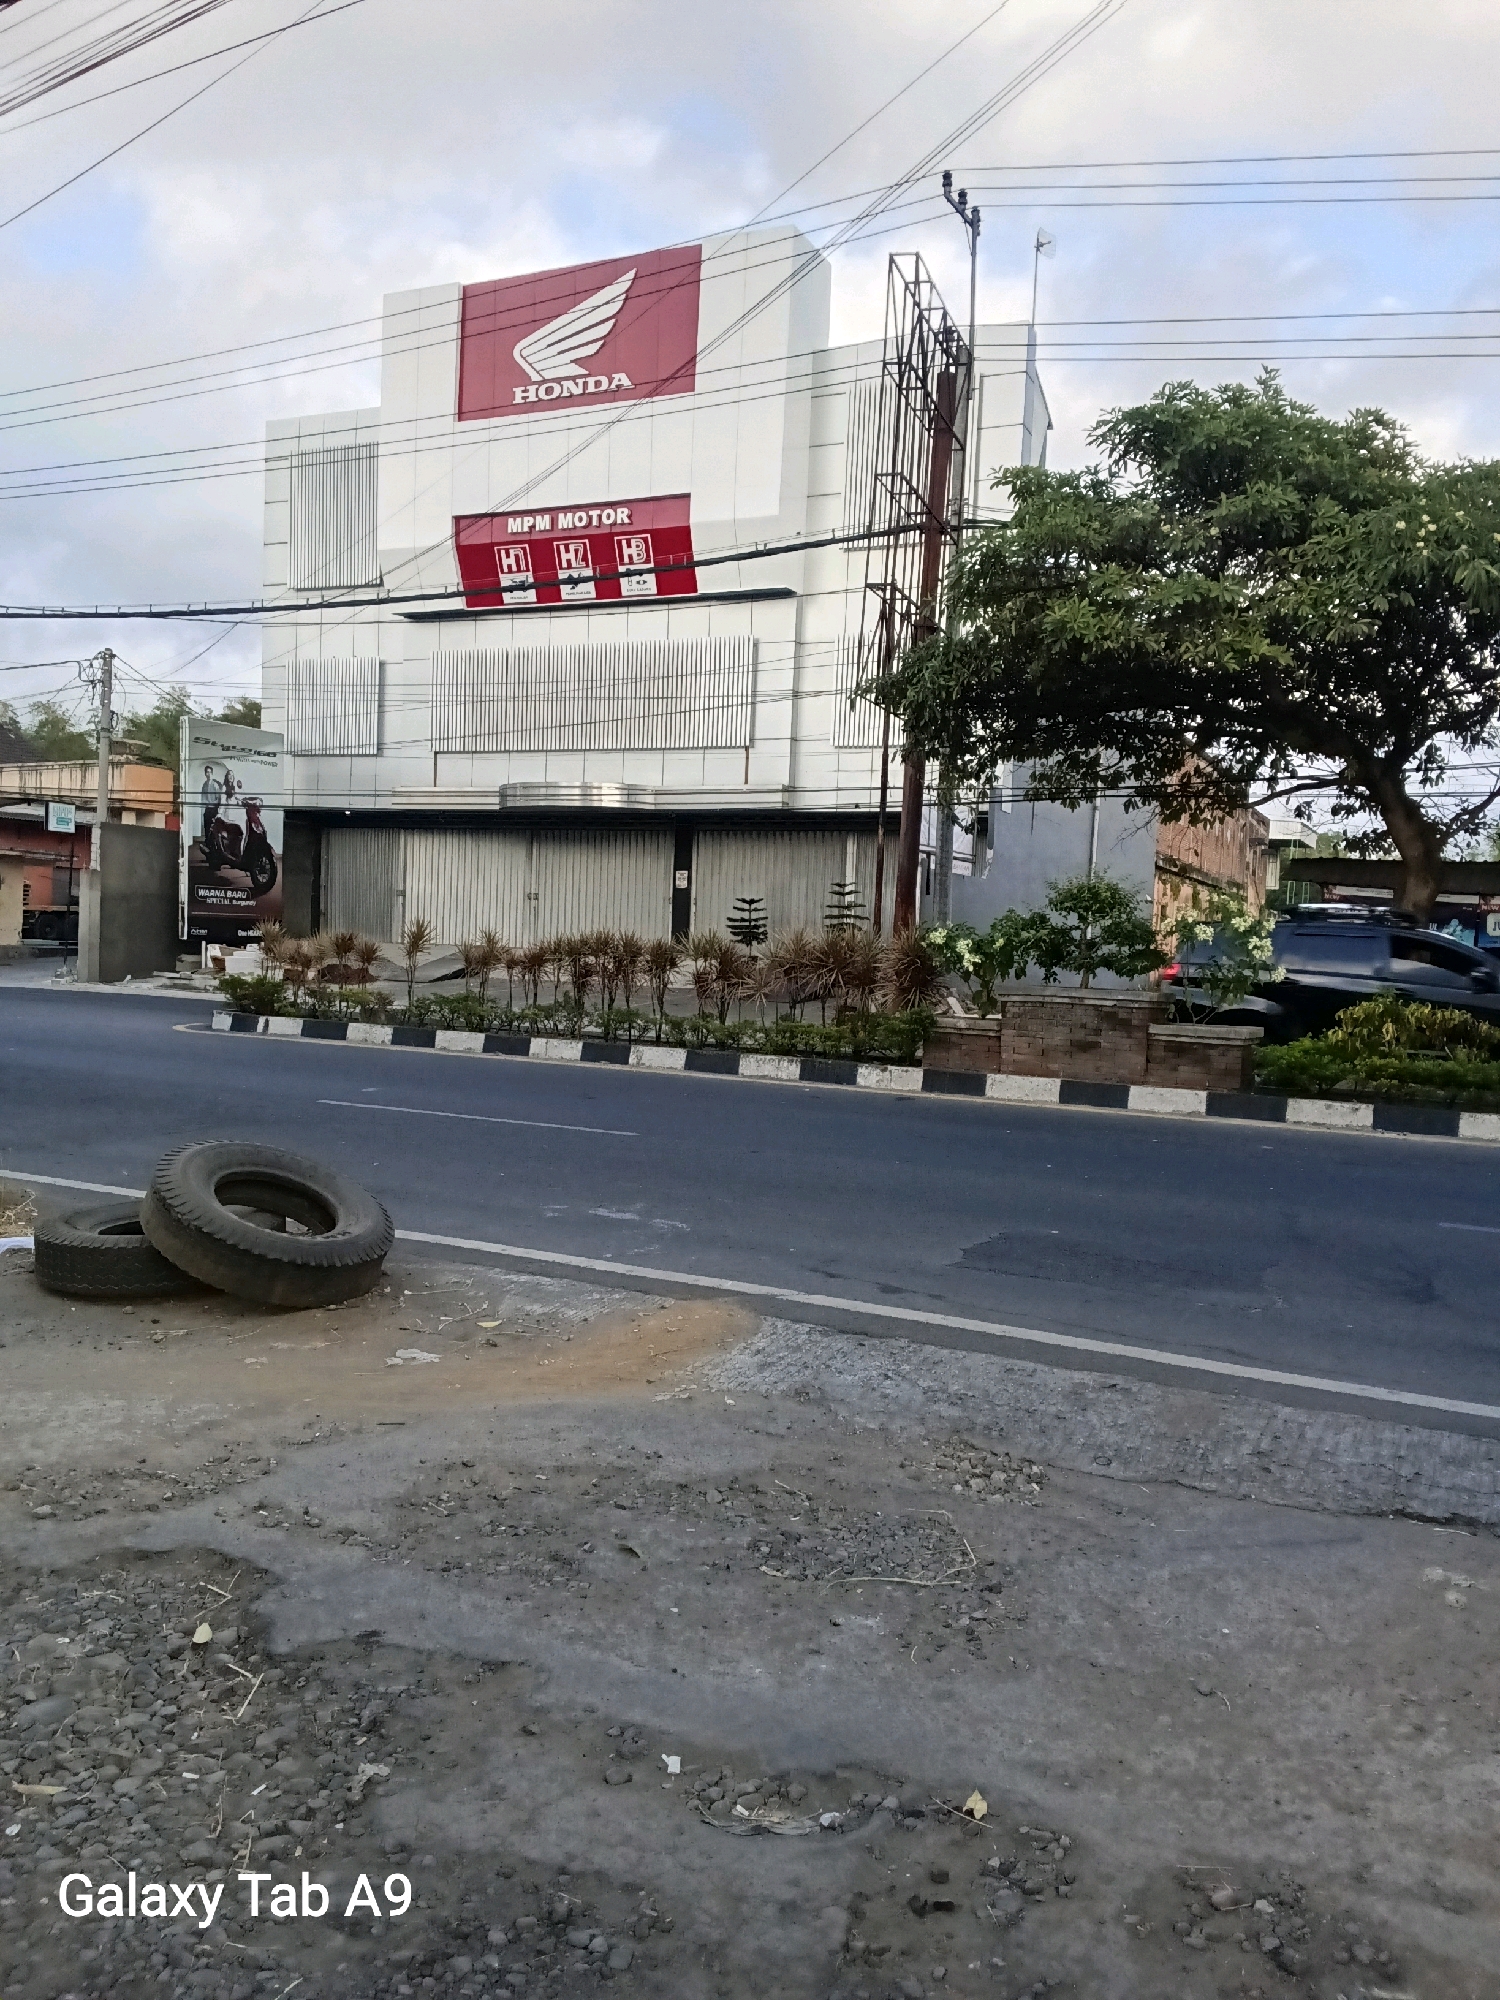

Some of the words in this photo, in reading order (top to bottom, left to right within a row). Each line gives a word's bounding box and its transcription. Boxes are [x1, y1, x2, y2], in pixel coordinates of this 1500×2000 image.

[513, 373, 635, 404] HONDA
[507, 514, 552, 533] MPM
[558, 508, 632, 530] MOTOR
[198, 888, 226, 898] WARNA
[226, 890, 248, 899] BARU
